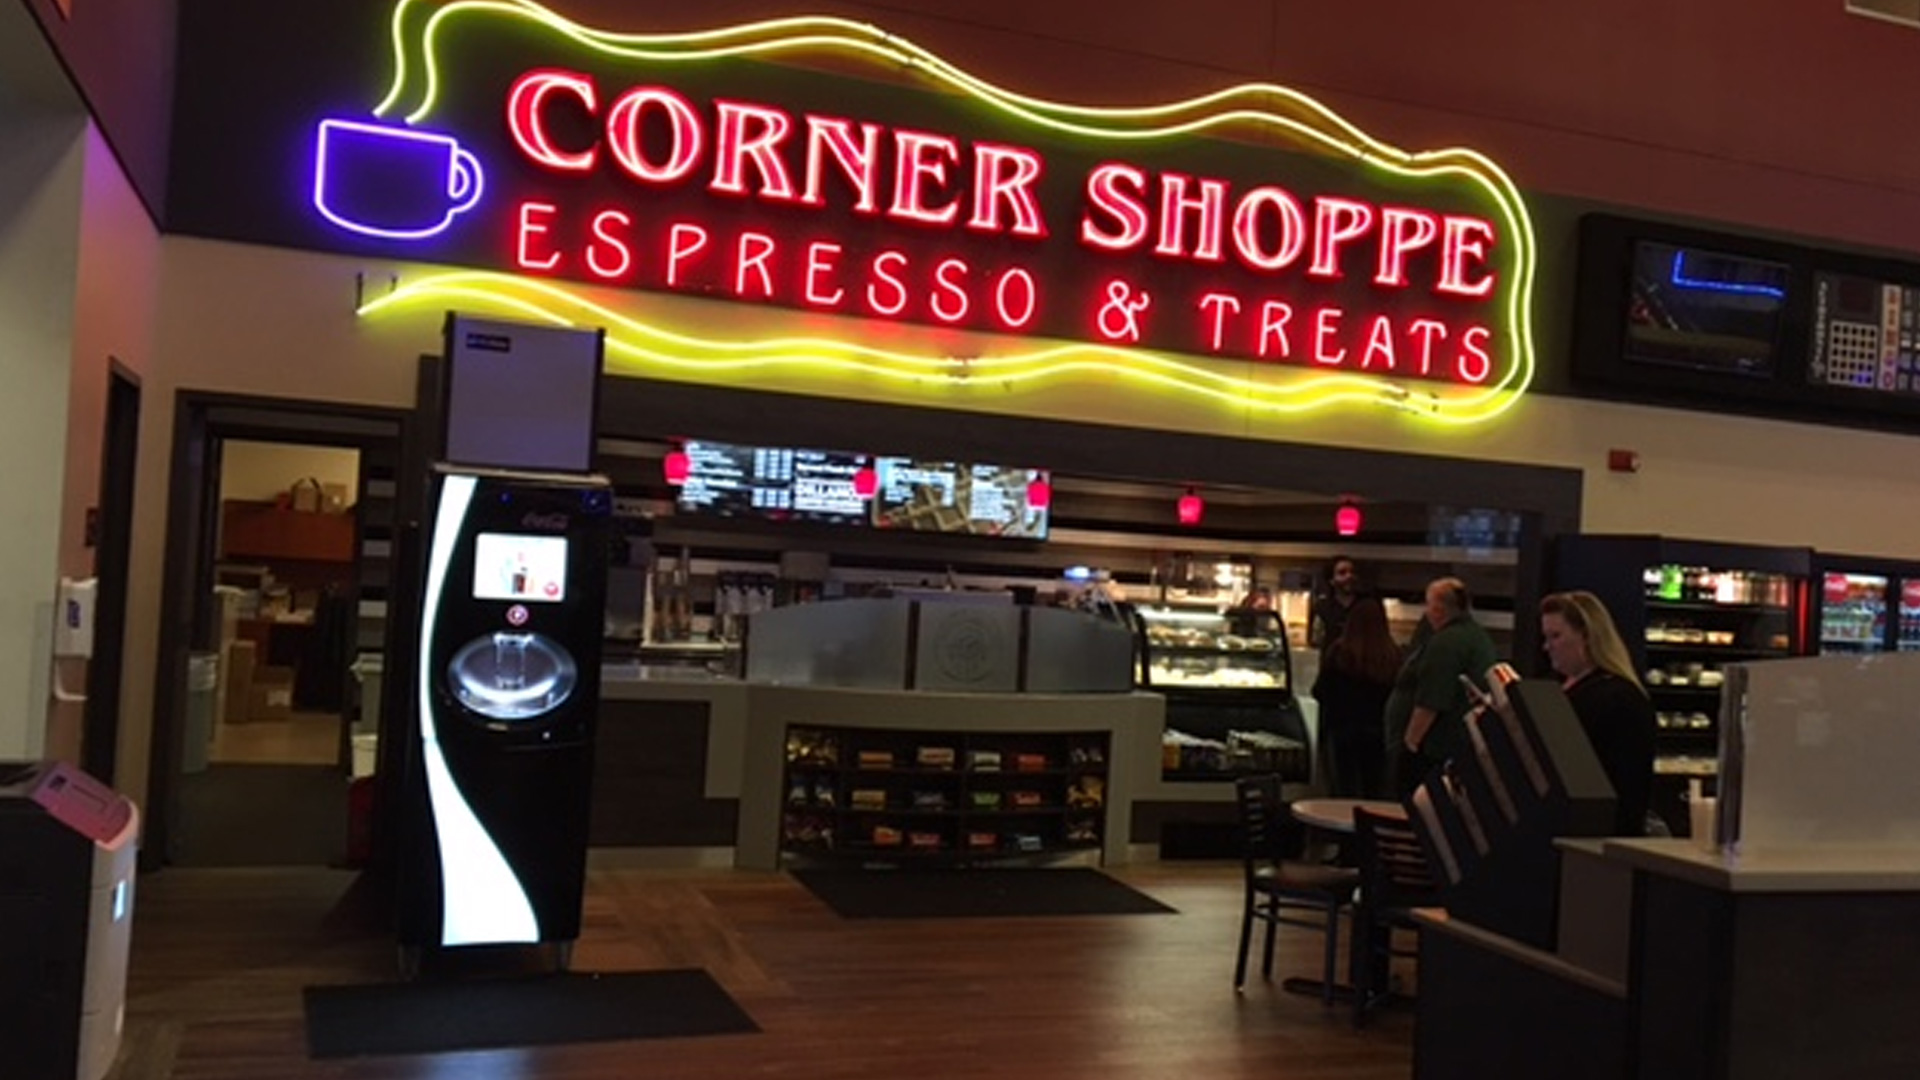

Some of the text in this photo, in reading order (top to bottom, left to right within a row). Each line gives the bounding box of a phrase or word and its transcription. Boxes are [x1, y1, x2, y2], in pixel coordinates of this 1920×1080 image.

[506, 70, 1495, 297] CORNER SHOPPE
[516, 201, 1491, 384] ESPRESSO & TREATS
